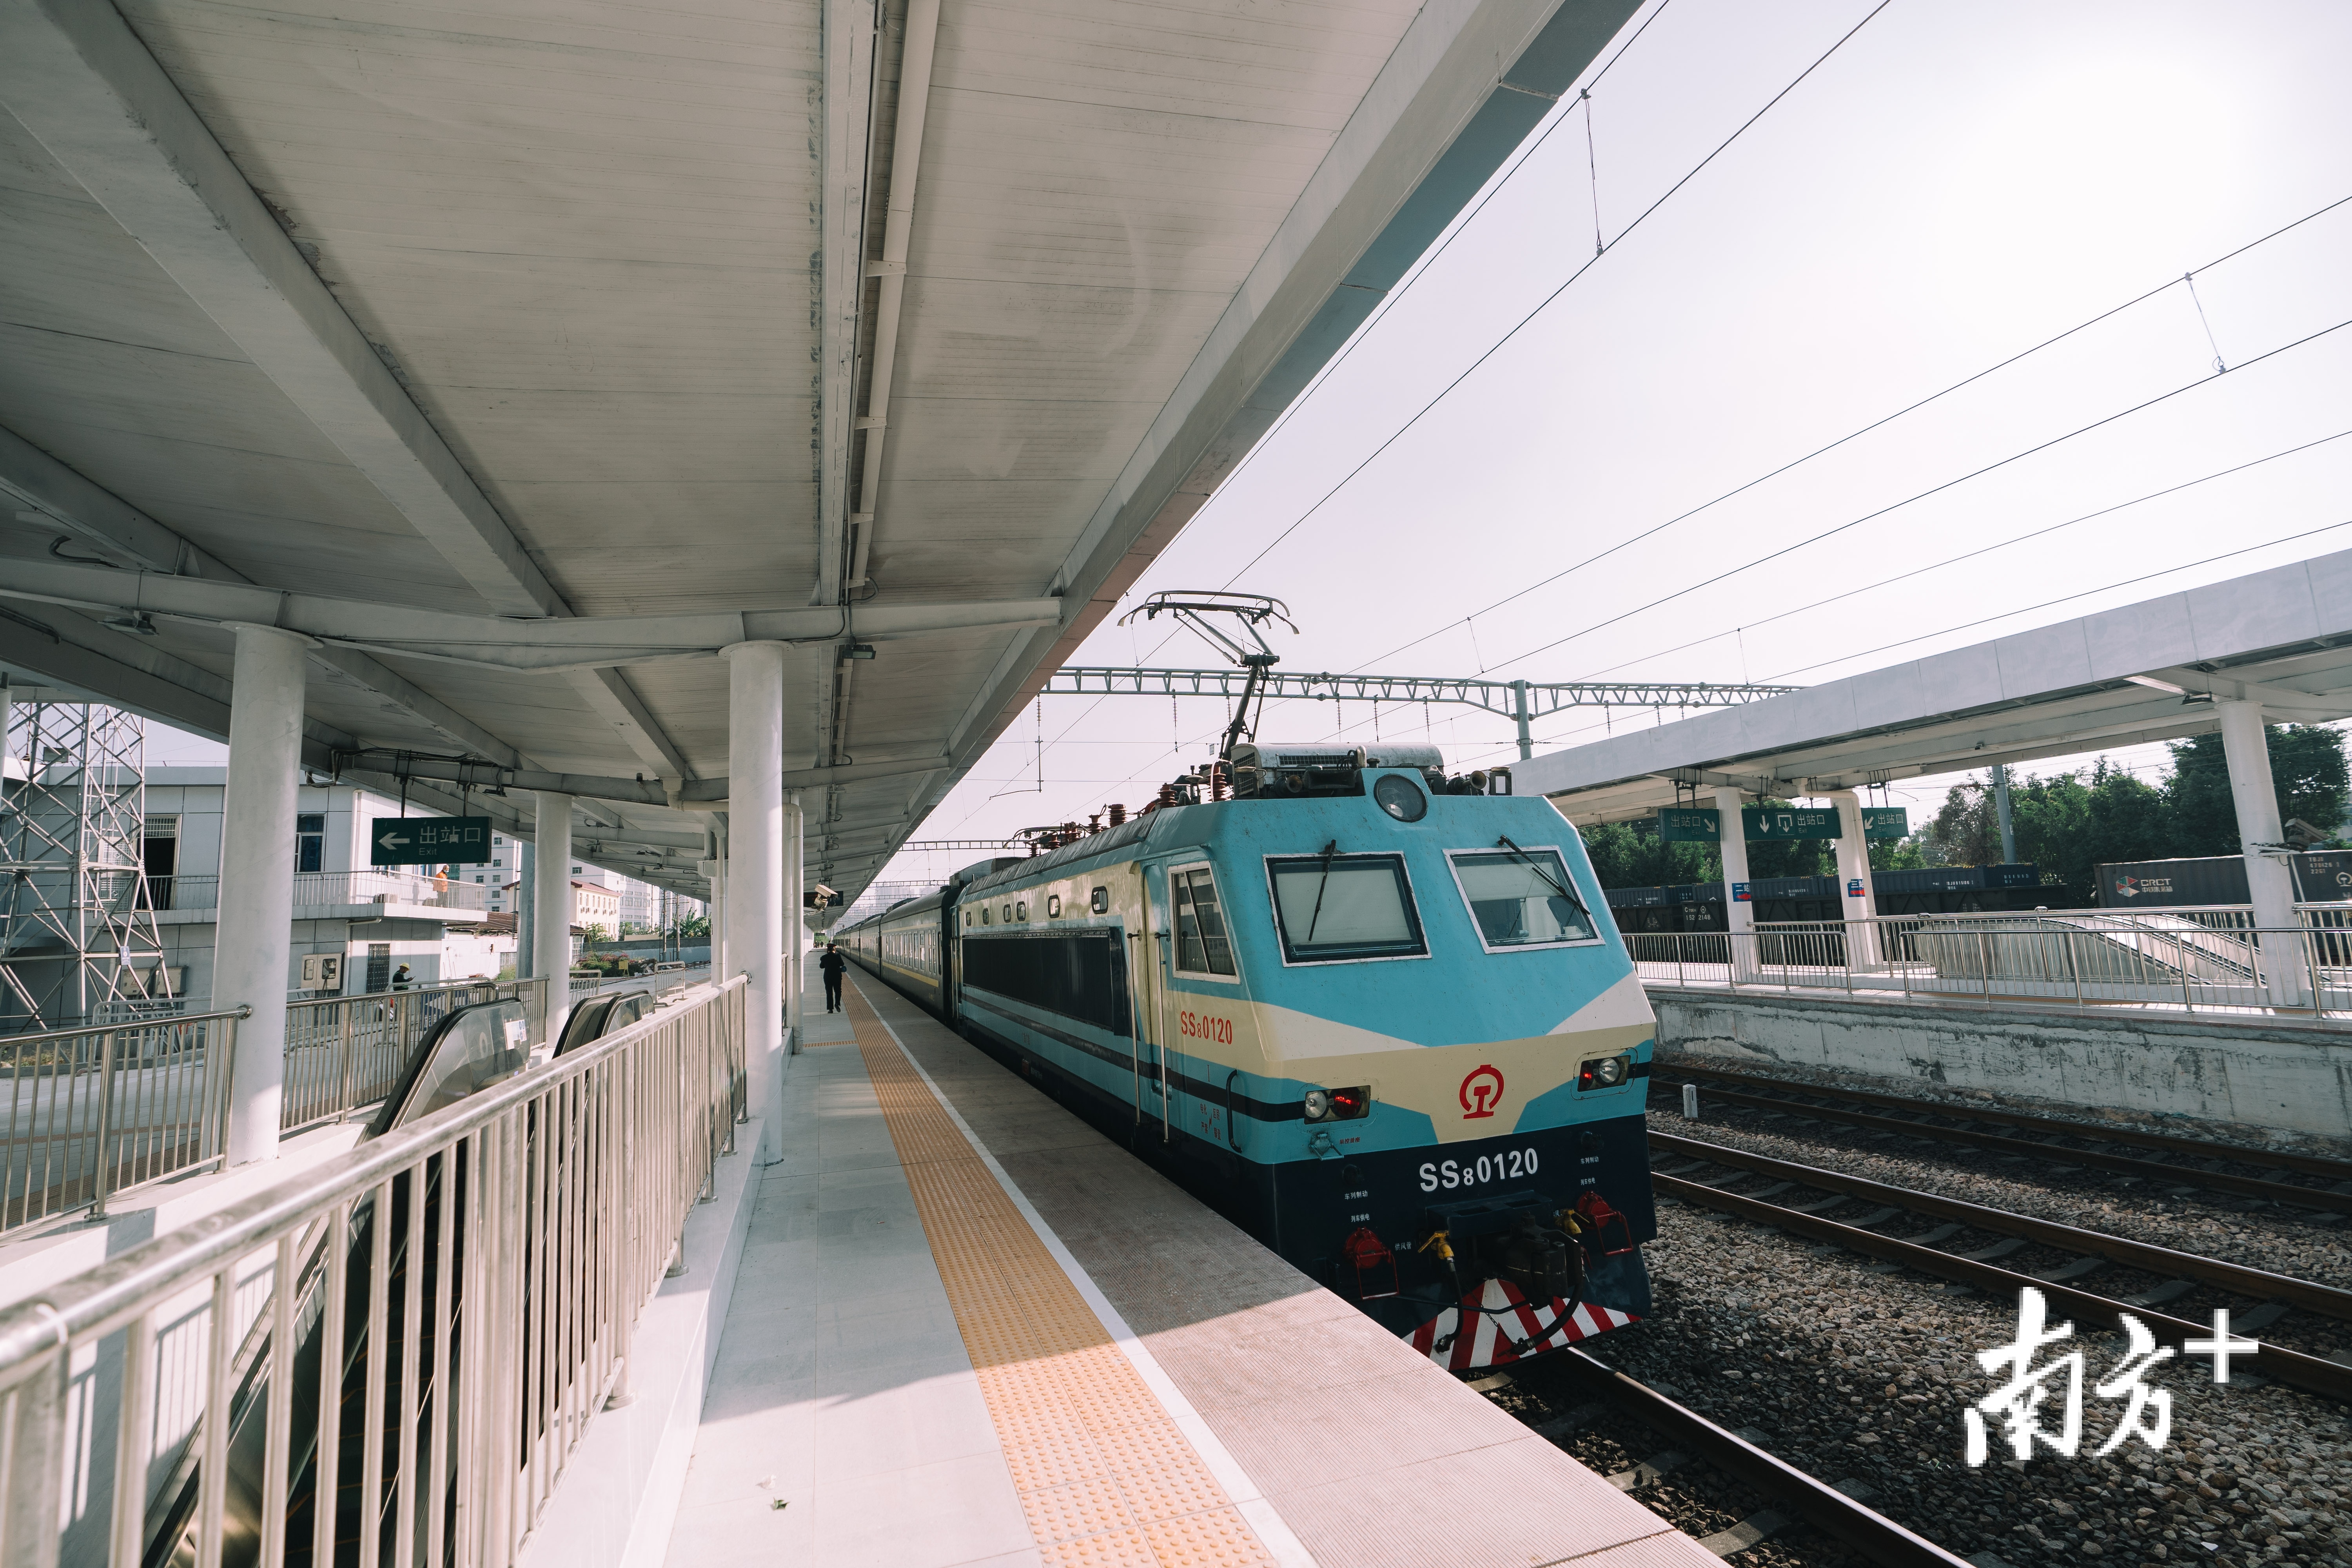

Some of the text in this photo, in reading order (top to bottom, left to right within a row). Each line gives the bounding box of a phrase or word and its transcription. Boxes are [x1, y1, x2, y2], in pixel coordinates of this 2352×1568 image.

[1671, 815, 1700, 828] 出站口
[1797, 814, 1825, 826] 出站口
[1878, 813, 1904, 825] 出站口
[419, 826, 481, 844] 出站口
[419, 847, 437, 855] Exit
[1181, 1011, 1232, 1045] SS80120
[1200, 1103, 1220, 1120] 电化 区段
[1201, 1121, 1208, 1134] 严禁
[1580, 1156, 1599, 1164] 车列制动
[1419, 1148, 1538, 1192] SS80120
[1581, 1177, 1595, 1185] 列车供电
[1345, 1190, 1368, 1200] 车列制动
[1351, 1213, 1370, 1222] 列车供电
[1395, 1241, 1412, 1251] 供风管
